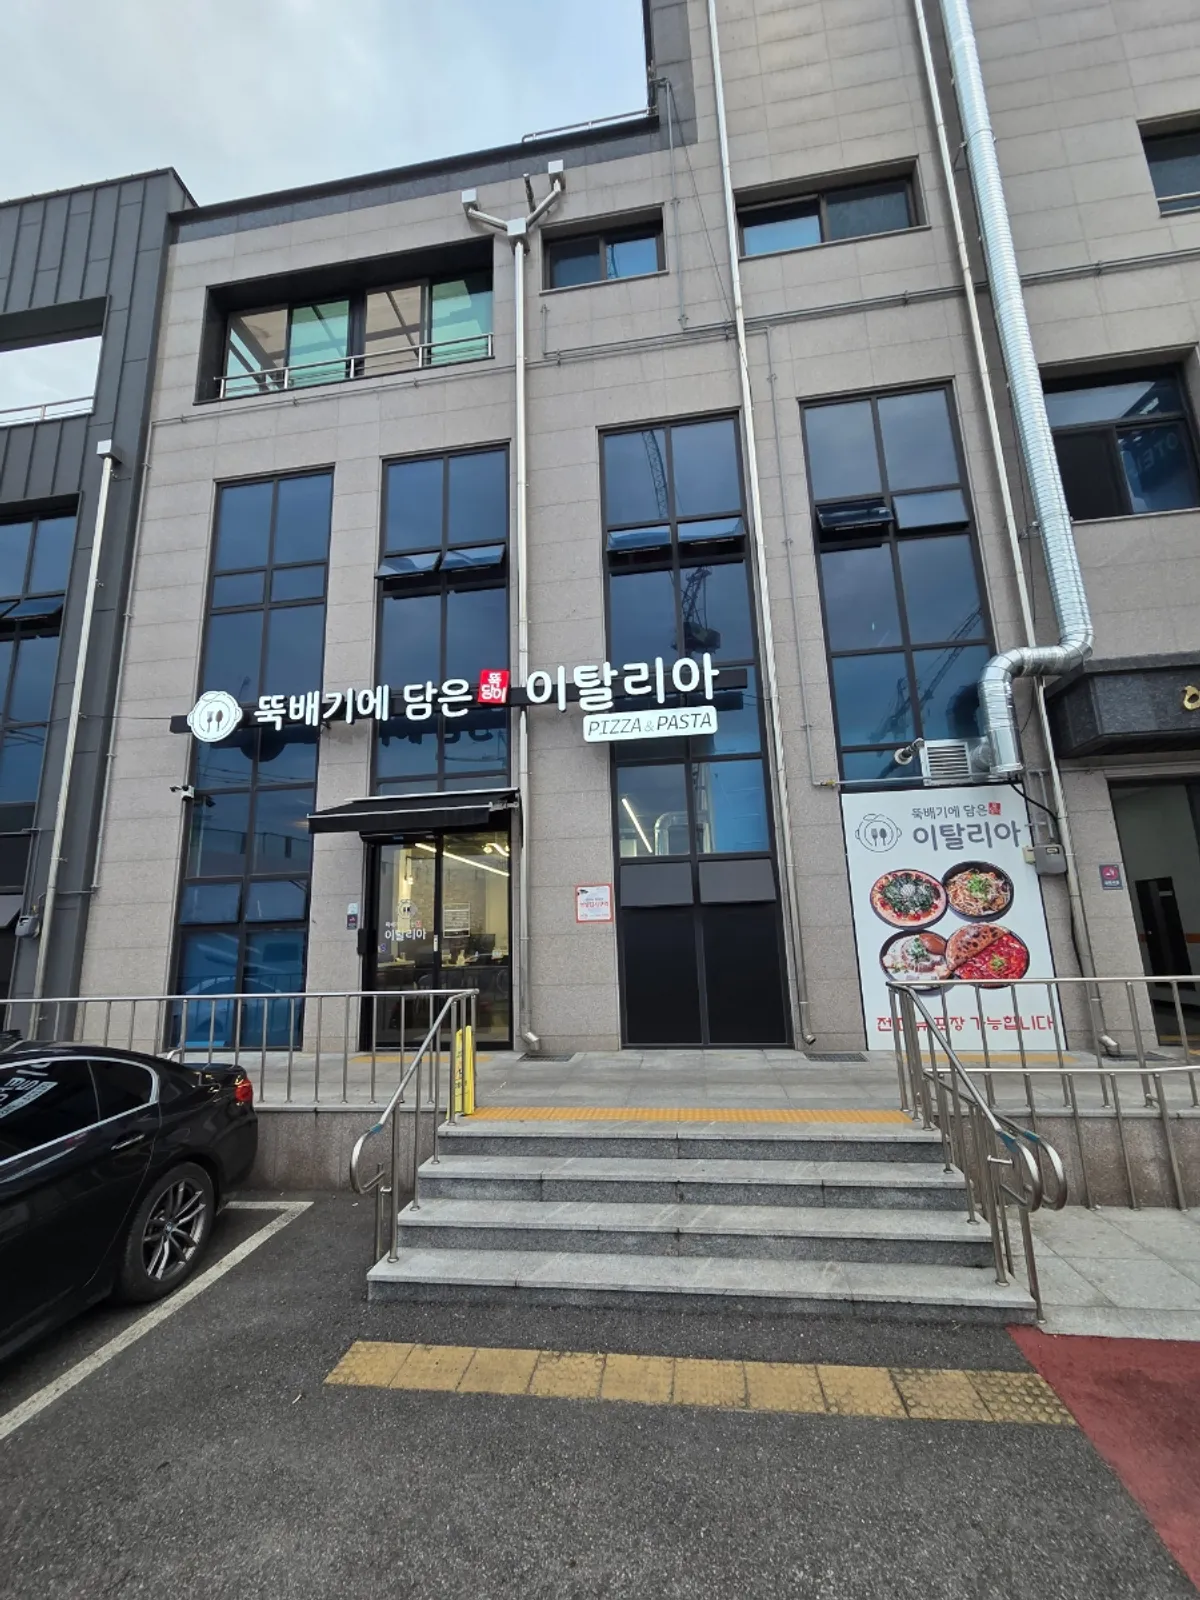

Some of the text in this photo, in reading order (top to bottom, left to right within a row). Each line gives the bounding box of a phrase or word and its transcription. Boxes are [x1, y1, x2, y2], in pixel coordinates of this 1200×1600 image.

[253, 652, 720, 732] 뚝배기에 담은 이탈리아
[911, 804, 961, 820] 뚝배기에
[963, 803, 988, 817] 담은
[912, 820, 1021, 851] 이탈리아
[969, 1014, 1056, 1031] 가능합니다
